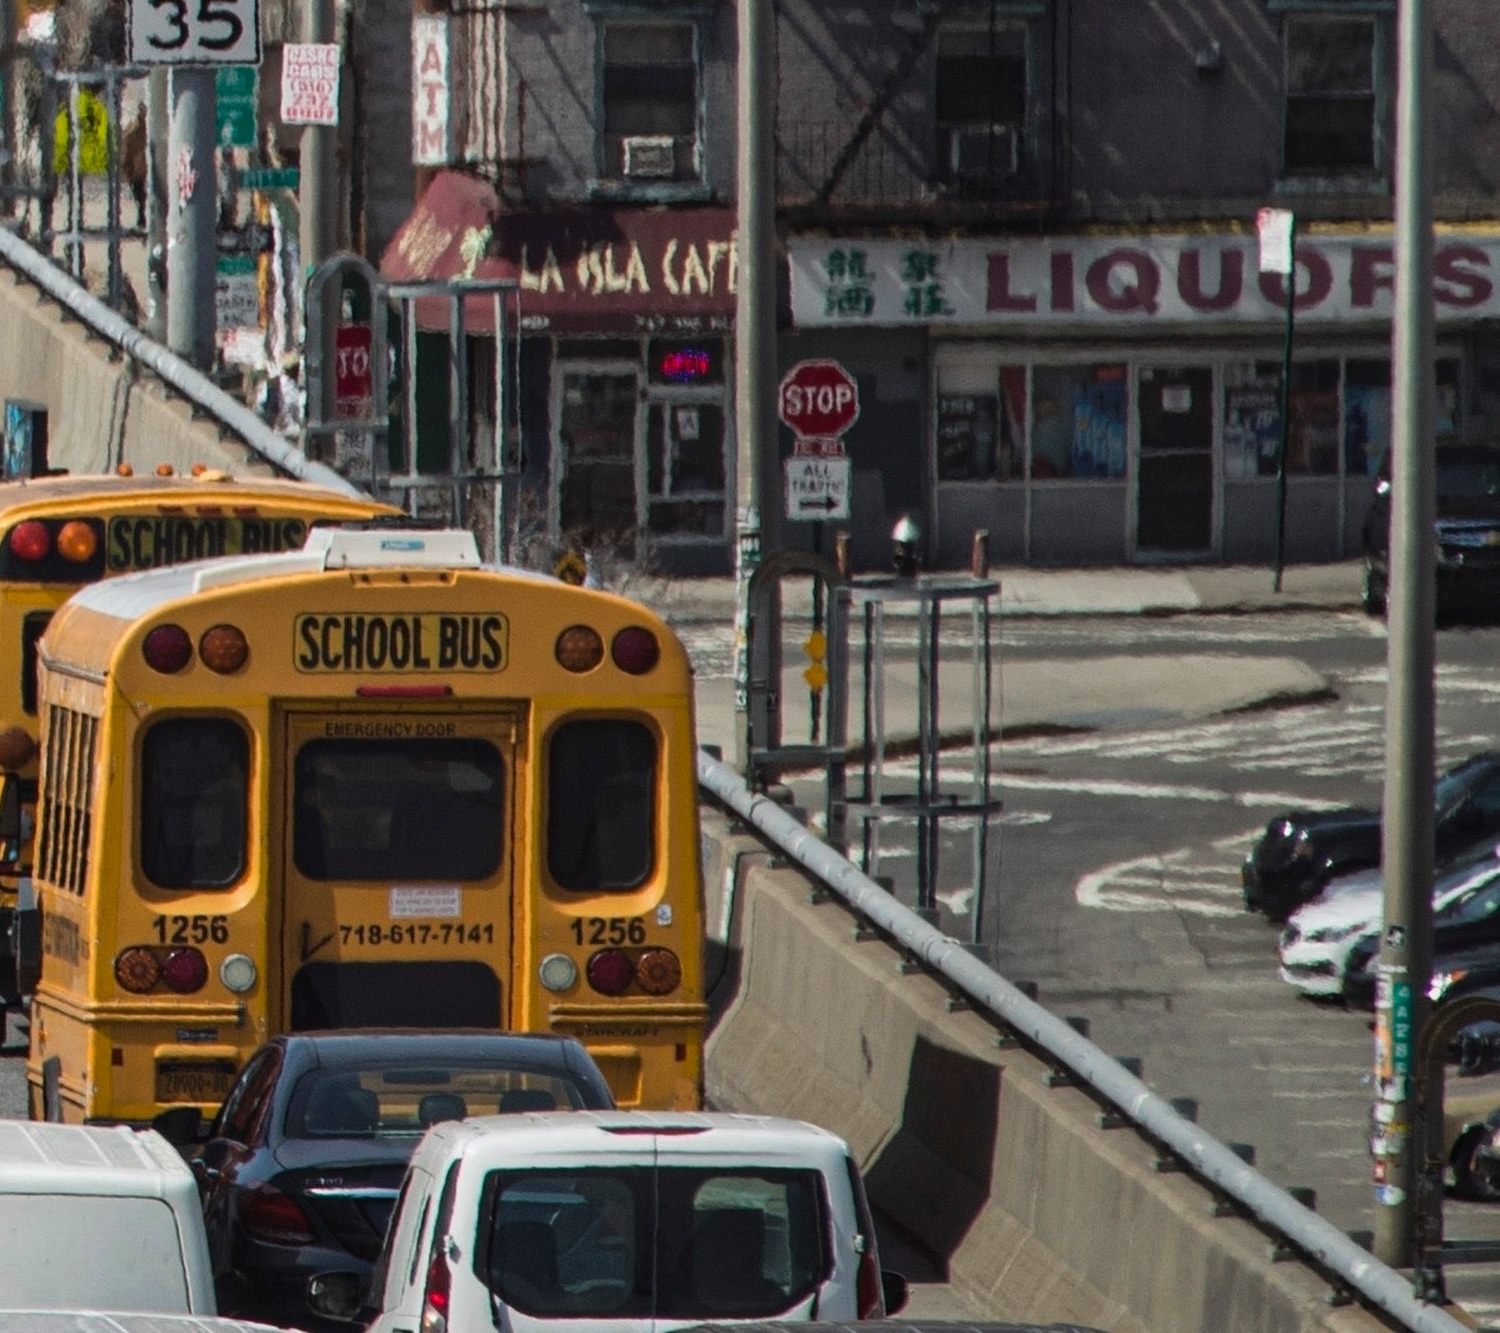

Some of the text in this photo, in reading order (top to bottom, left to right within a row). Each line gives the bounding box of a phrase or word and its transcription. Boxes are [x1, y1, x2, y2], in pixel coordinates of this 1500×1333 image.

[420, 43, 444, 156] ATM
[521, 244, 564, 294] LA
[577, 239, 651, 295] ISLA
[986, 246, 1494, 317] LIQUORS
[786, 384, 852, 416] STOP
[300, 616, 503, 669] SCHOOL BUS
[325, 723, 456, 735] EMERGENCY DOOR
[152, 915, 230, 945] 1256
[339, 923, 495, 945] 718-617-7141
[570, 917, 647, 946] 1256
